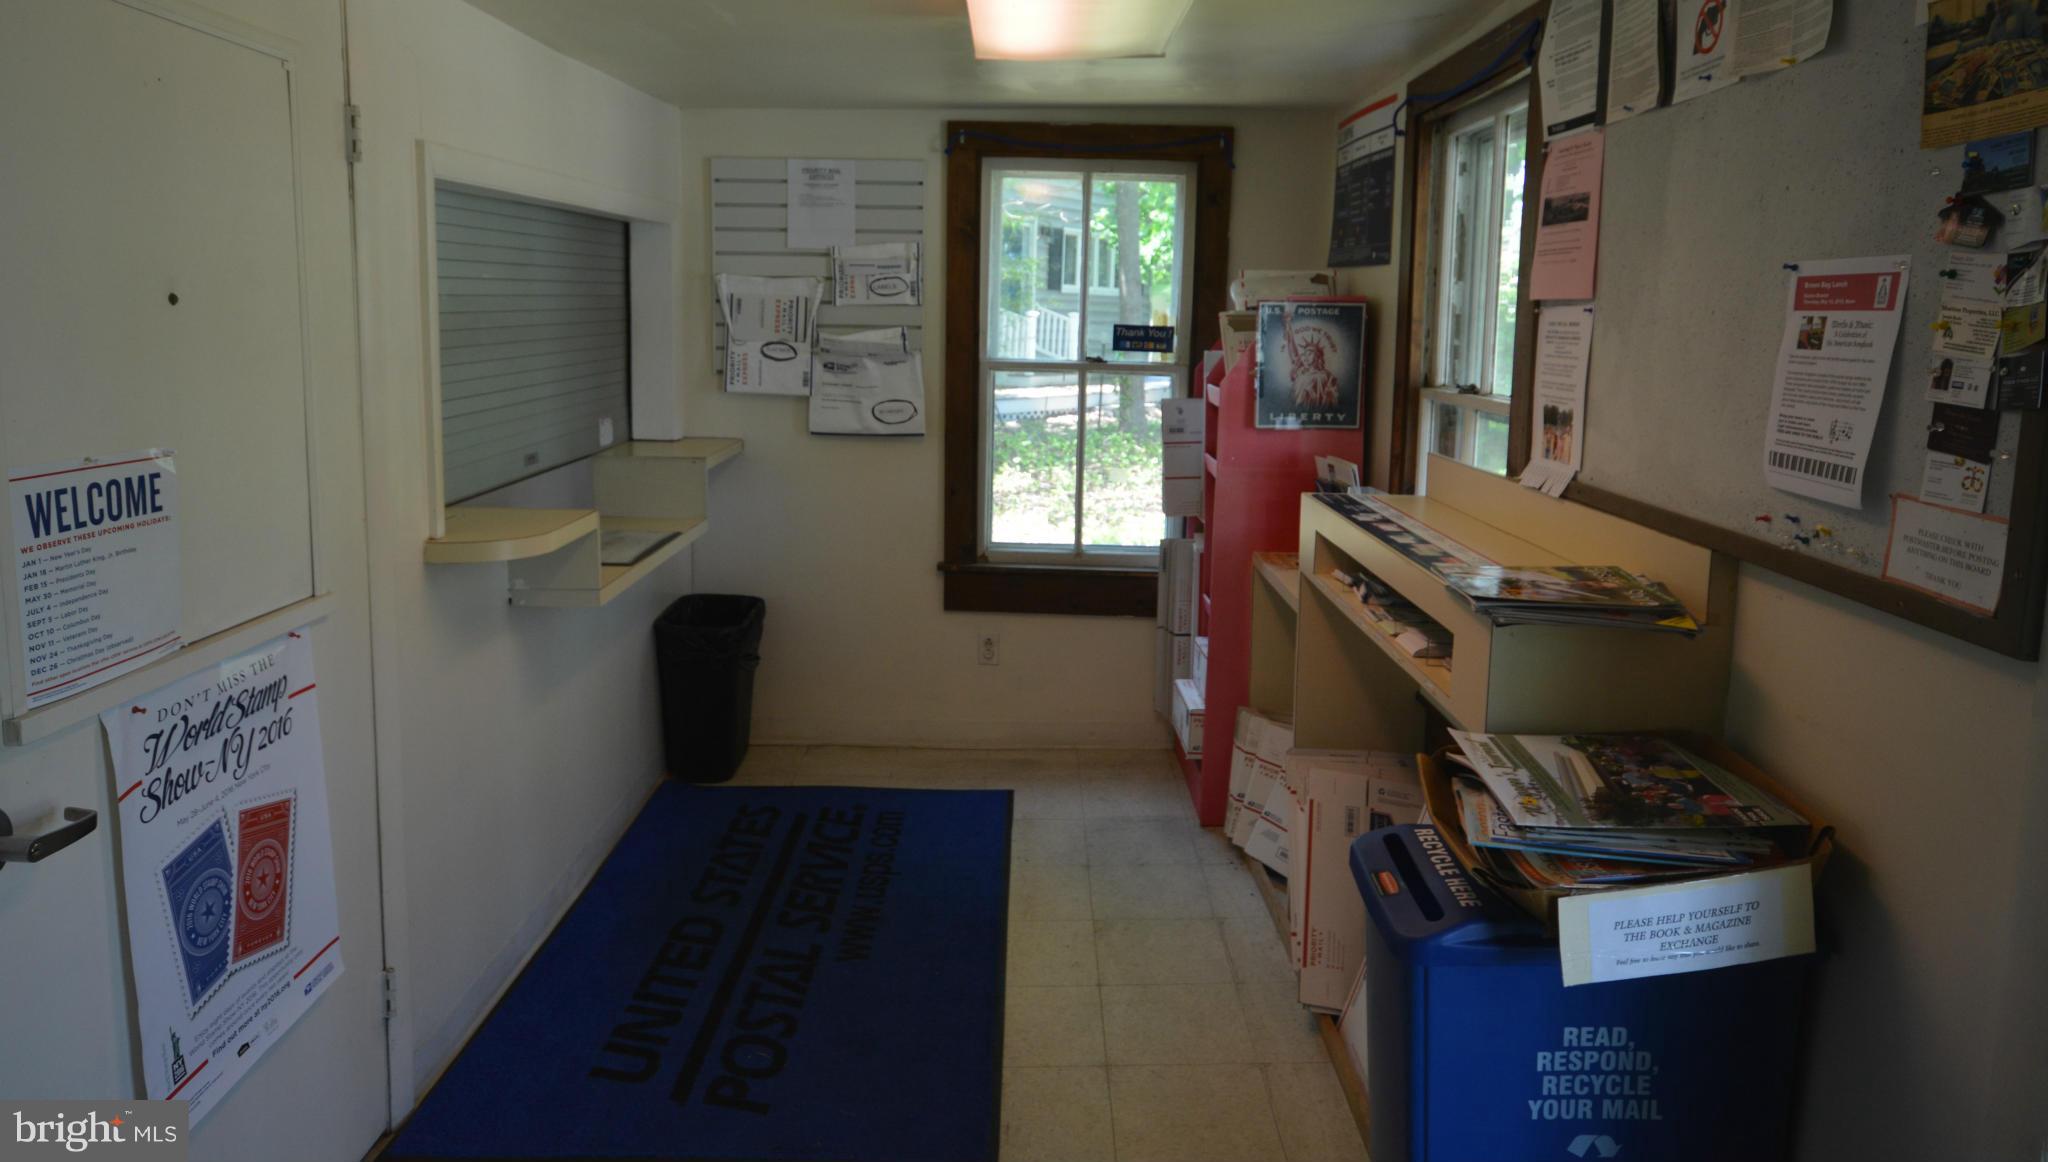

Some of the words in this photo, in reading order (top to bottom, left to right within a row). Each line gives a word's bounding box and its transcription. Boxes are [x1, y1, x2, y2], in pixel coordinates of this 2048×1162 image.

[1298, 307, 1341, 316] POSTAGE
[1116, 327, 1145, 338] Thank
[1270, 413, 1346, 422] LIBERTY
[25, 472, 163, 538] WELCOME
[20, 545, 34, 555] WE
[36, 536, 71, 551] OBSERVE
[73, 531, 96, 542] THESE
[98, 523, 135, 537] UPCOMING
[1963, 541, 1984, 552] WITH
[22, 558, 37, 568] JAN
[1968, 553, 2000, 568] POSTING
[23, 570, 38, 580] JAN
[1965, 562, 1992, 576] BOARD
[24, 583, 39, 592] FEB
[25, 596, 41, 605] MAY
[26, 606, 44, 617] JULY
[26, 618, 46, 629] SEPT
[28, 630, 44, 641] OCT
[28, 642, 46, 653] NOV
[30, 654, 47, 665] NOV
[31, 666, 47, 677] DEC
[157, 688, 212, 722] DON'T
[216, 672, 246, 696] MISS
[250, 654, 275, 676] THE
[144, 694, 232, 776] World
[225, 675, 288, 729] Stamp
[1414, 828, 1461, 876] RECYCLE
[1444, 878, 1482, 907] HERE
[1614, 917, 1653, 931] PLEASE
[1656, 913, 1686, 926] HELP
[1689, 903, 1743, 921] YOURSELF
[1744, 901, 1760, 912] TO
[1623, 931, 1646, 942] THE
[1650, 926, 1681, 940] BOOK
[1683, 925, 1692, 935] &
[1695, 915, 1752, 934] MAGAZINE
[588, 914, 724, 1084] UNITED
[692, 803, 781, 907] STATES
[1660, 934, 1719, 951] EXCHANGE
[1616, 957, 1629, 966] Feel
[1725, 944, 1736, 952] like
[211, 1041, 227, 1058] Find
[227, 1030, 238, 1044] out
[238, 1016, 253, 1032] more
[703, 943, 823, 1116] POSTAL
[1562, 1026, 1635, 1050] READ,
[1535, 1050, 1661, 1076] RESPOND,
[1541, 1075, 1652, 1096] RECYCLE
[1528, 1099, 1594, 1121] YOUR
[1601, 1099, 1663, 1121] MAIL
